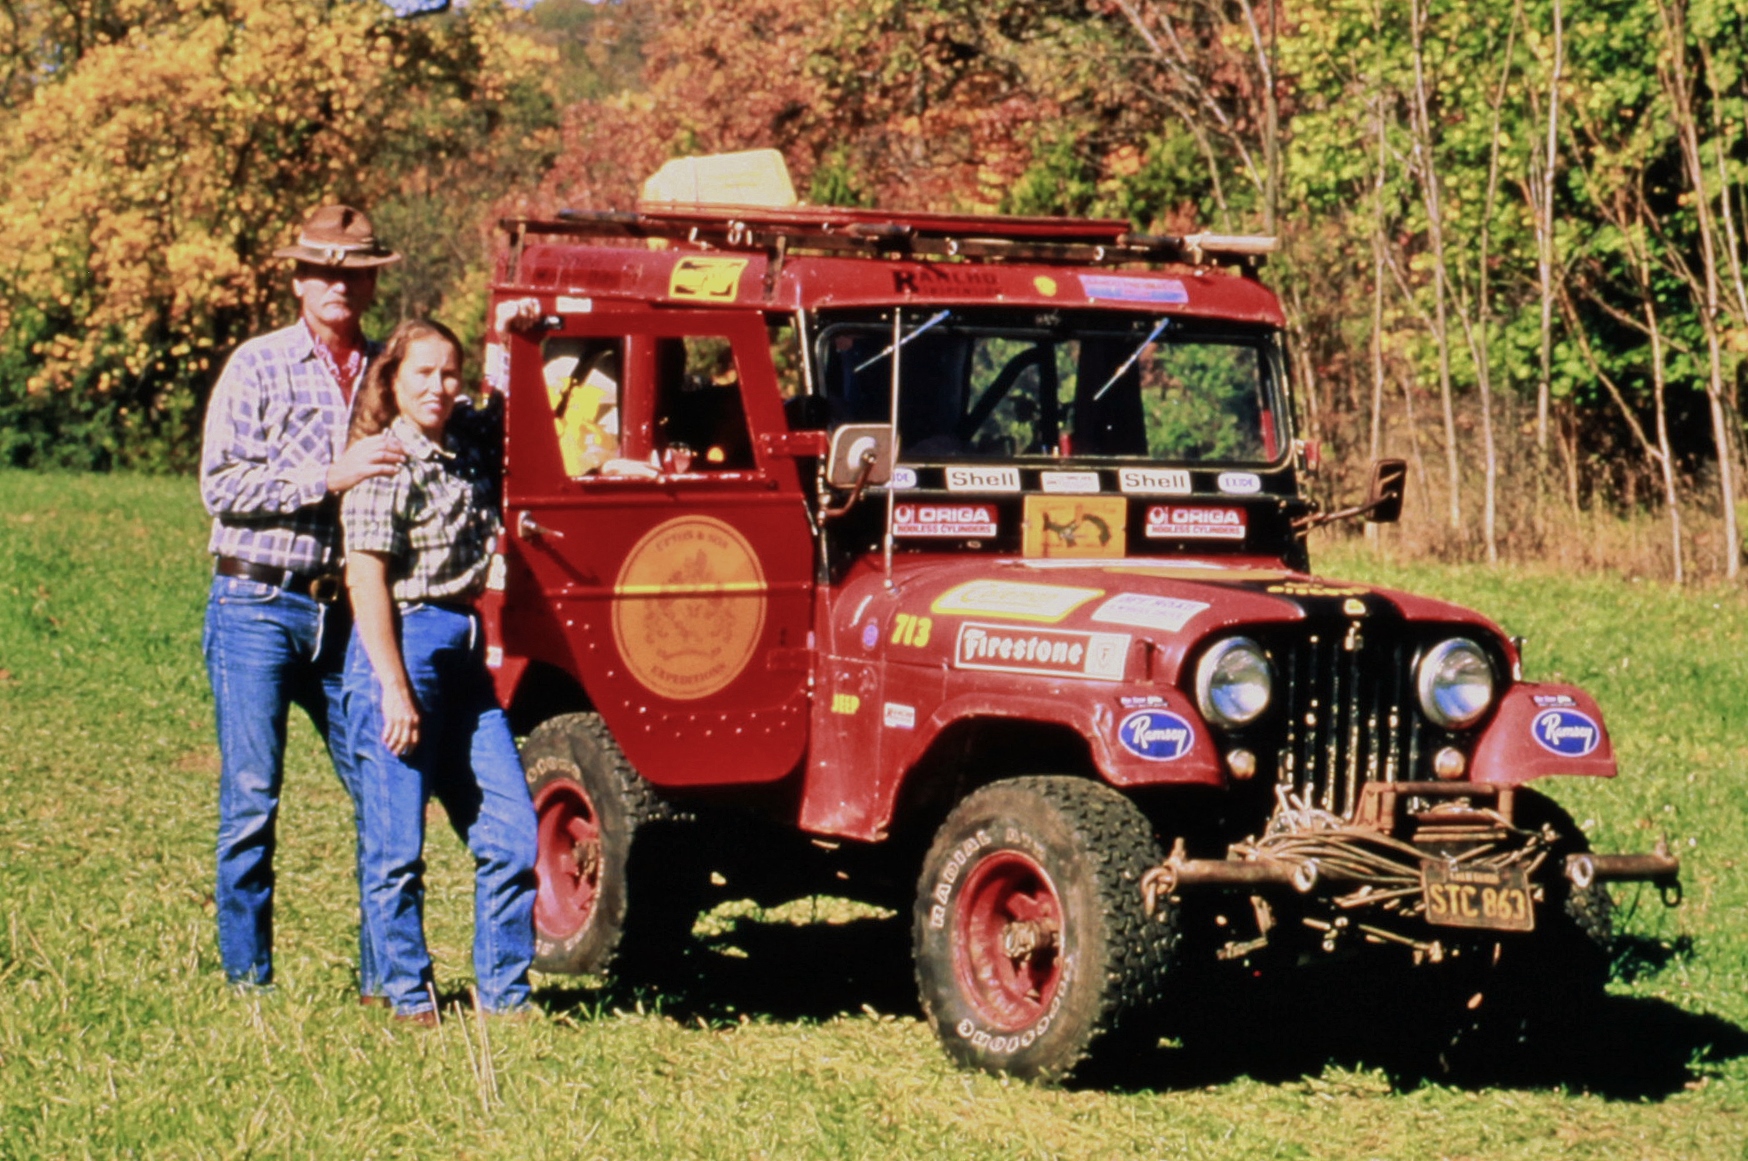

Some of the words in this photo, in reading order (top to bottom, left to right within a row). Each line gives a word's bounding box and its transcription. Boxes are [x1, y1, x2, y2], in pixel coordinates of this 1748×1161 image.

[951, 471, 1015, 487] Shell
[1124, 473, 1186, 489] Shell
[918, 507, 991, 523] ORIGA
[1172, 508, 1240, 524] ORIGA
[890, 612, 933, 648] 713
[962, 627, 1084, 665] Firestone
[1129, 714, 1188, 757] Ramsey
[1541, 712, 1594, 754] Ramsey
[929, 829, 993, 930] RADIAL
[1429, 883, 1479, 918] STC
[1481, 887, 1526, 920] 863
